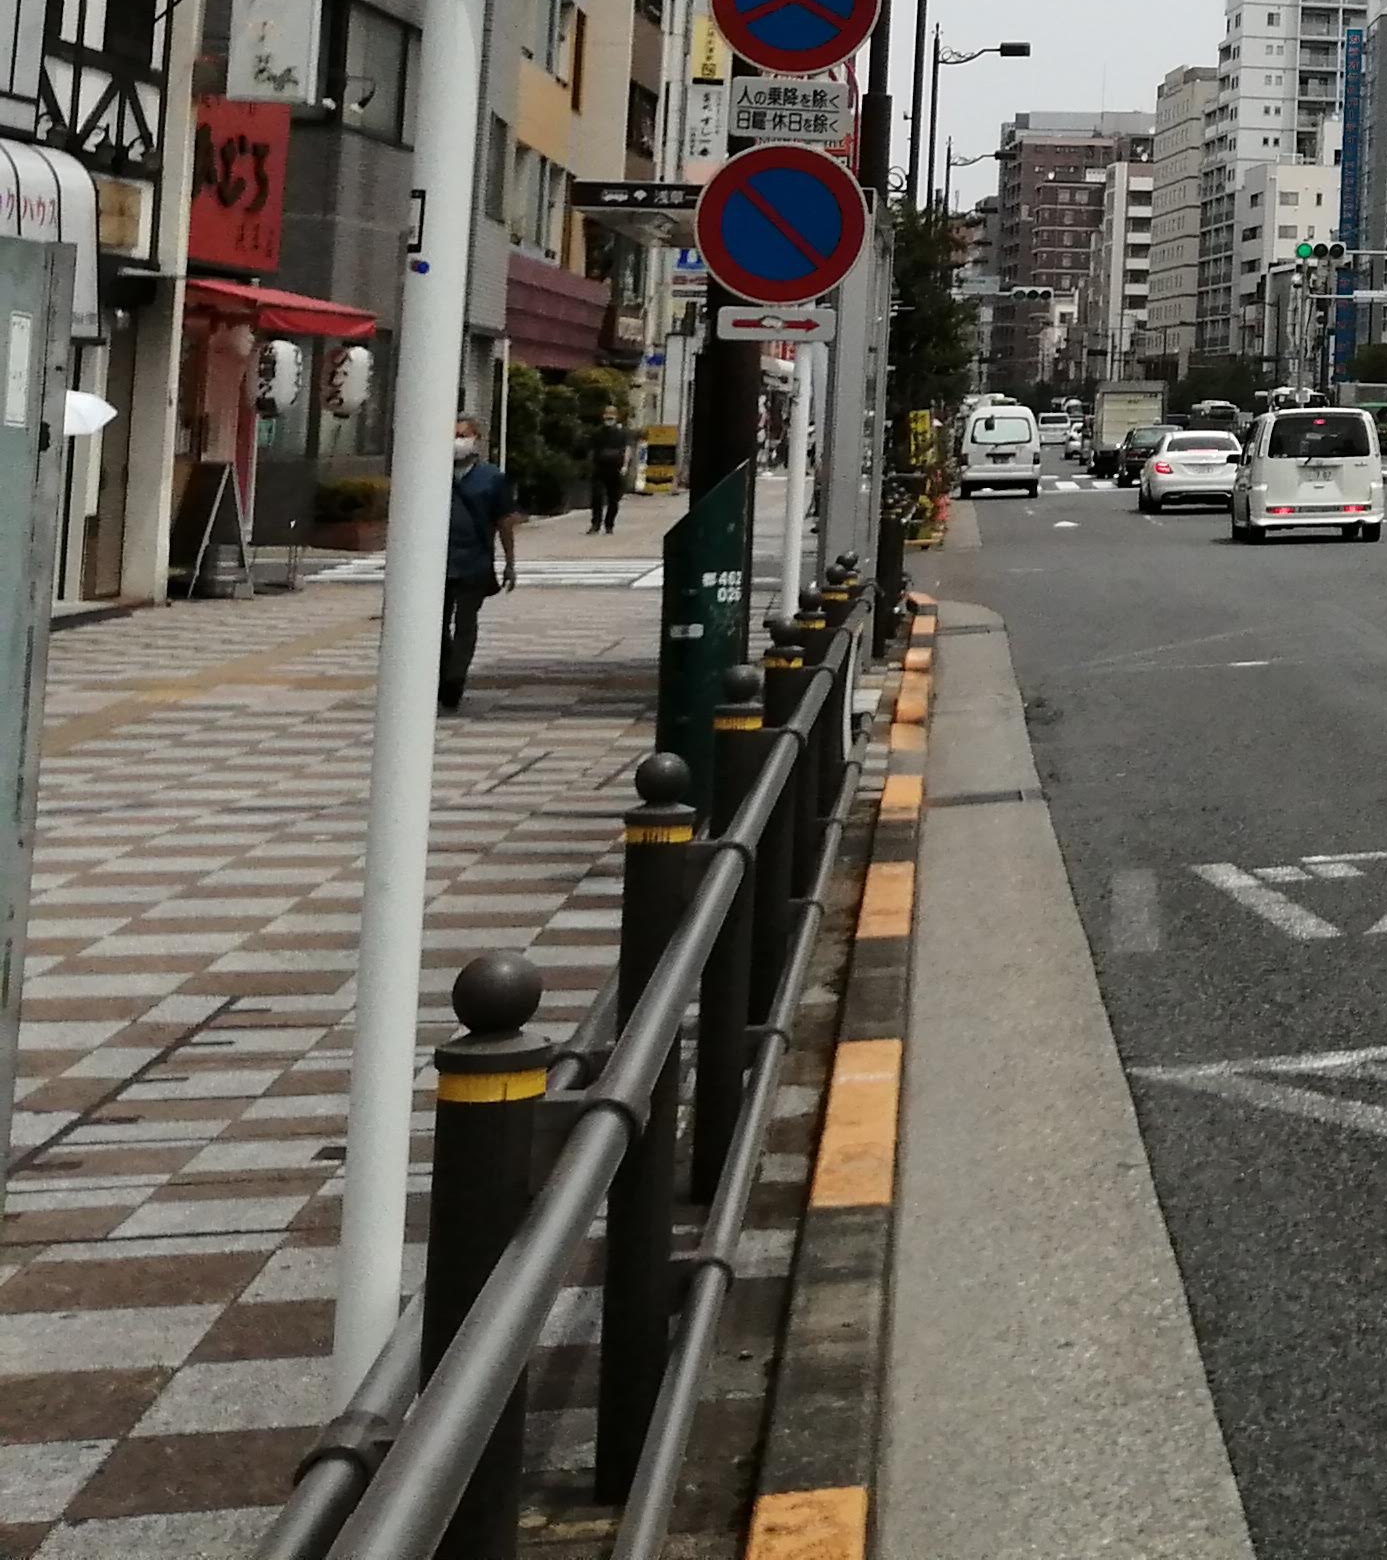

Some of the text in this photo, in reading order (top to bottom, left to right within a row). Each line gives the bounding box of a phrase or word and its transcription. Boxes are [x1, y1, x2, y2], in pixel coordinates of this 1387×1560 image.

[737, 85, 840, 109] 人の乗降を除く
